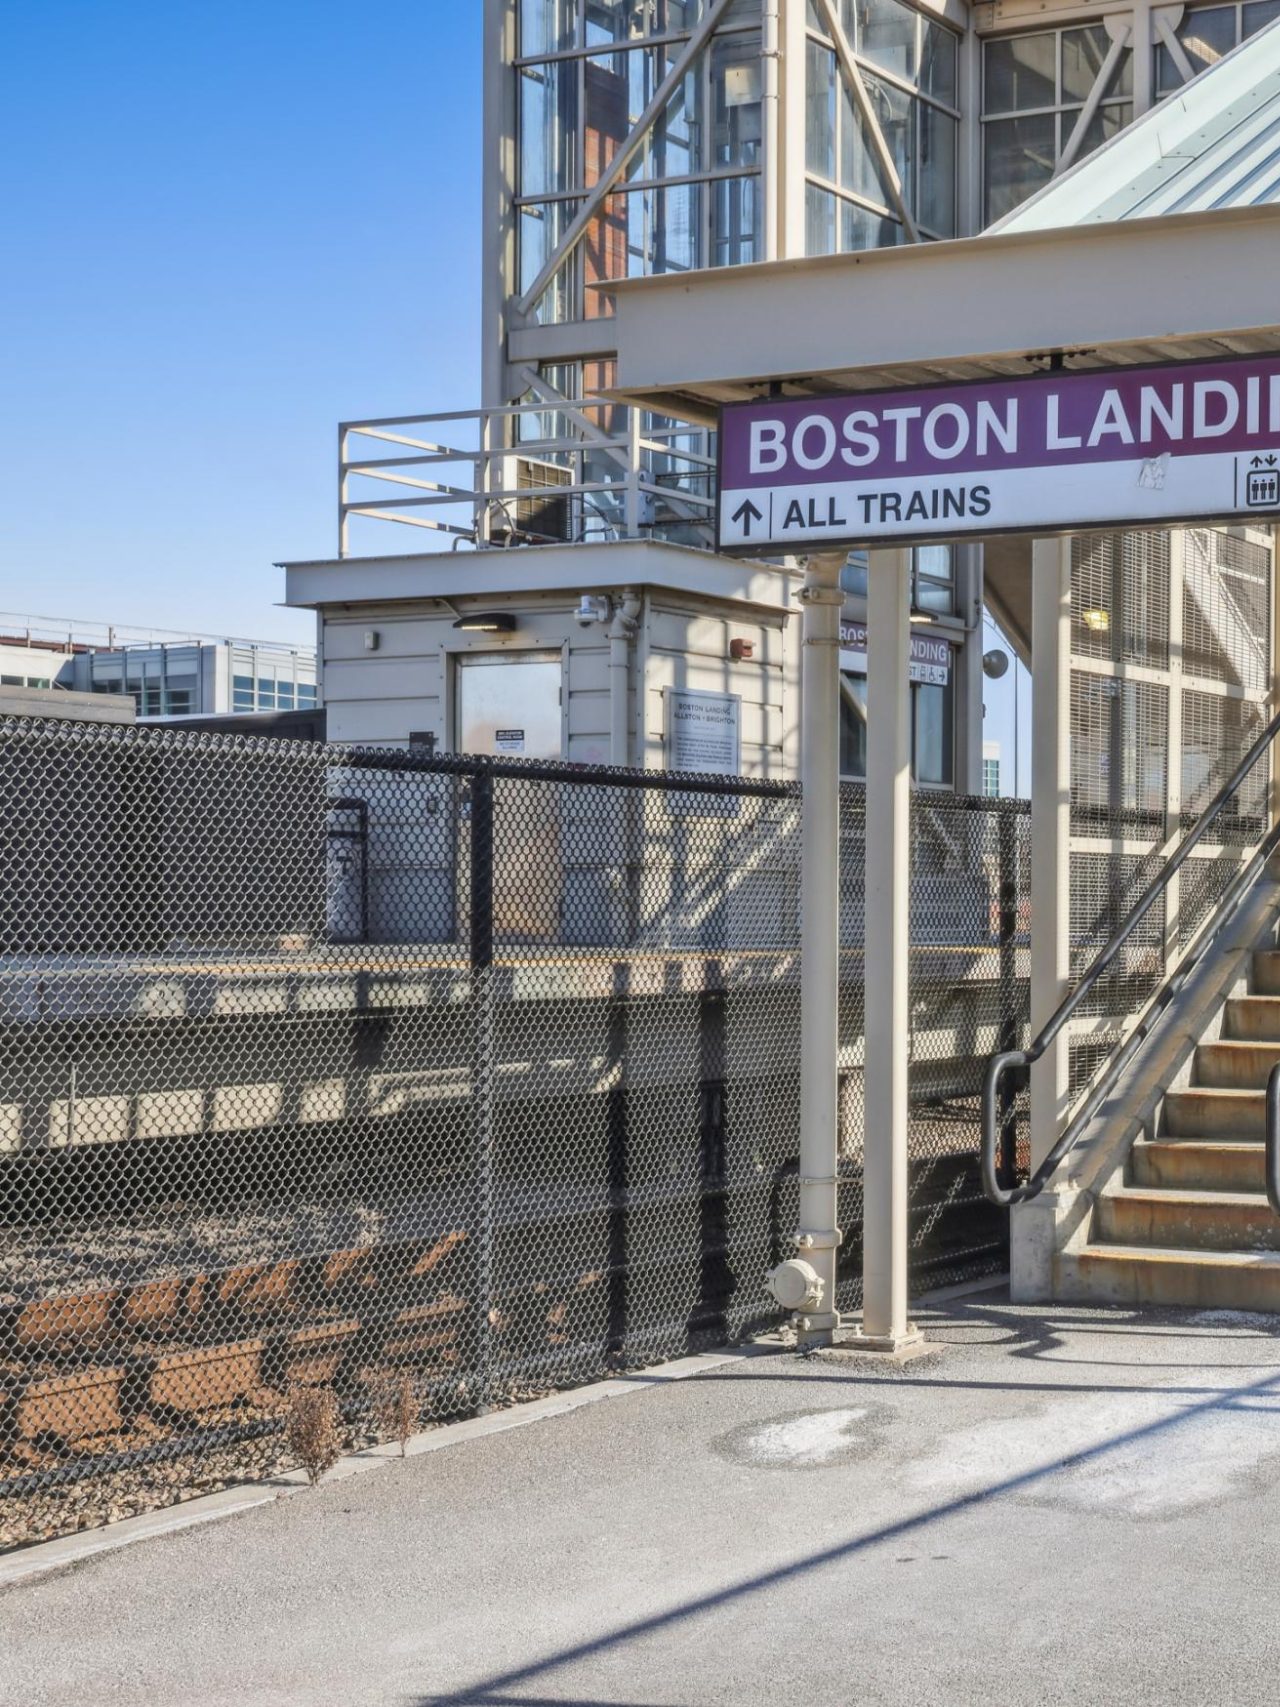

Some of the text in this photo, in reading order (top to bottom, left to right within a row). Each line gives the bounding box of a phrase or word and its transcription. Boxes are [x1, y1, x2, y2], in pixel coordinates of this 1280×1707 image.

[748, 397, 1019, 475] BOSTON
[781, 485, 992, 530] ALL TRAINS
[839, 626, 947, 661] BOS NDING
[678, 703, 731, 715] BOSTON LANDING
[706, 715, 736, 725] BRIGHTON
